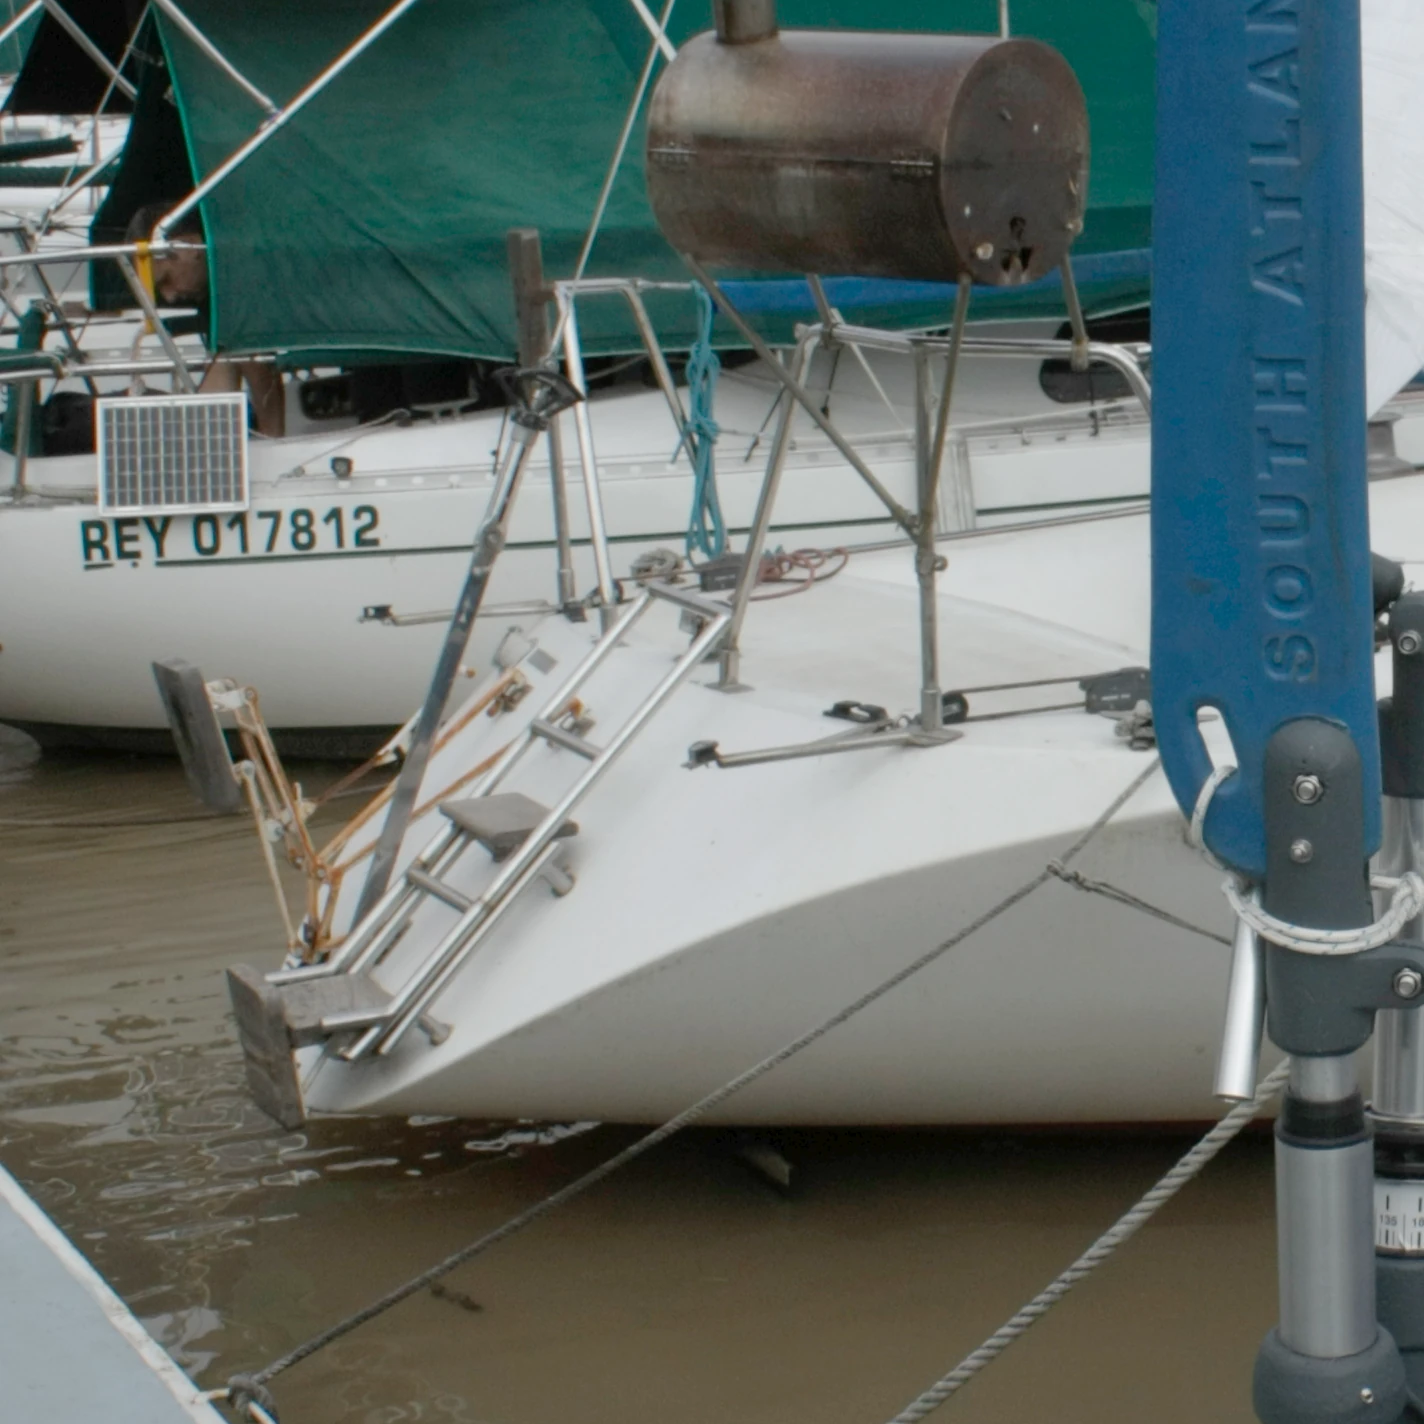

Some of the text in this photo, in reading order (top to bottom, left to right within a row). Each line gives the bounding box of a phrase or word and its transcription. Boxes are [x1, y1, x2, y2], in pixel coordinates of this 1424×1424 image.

[81, 504, 381, 562] REY 017812
[1253, 354, 1317, 683] SOUTH
